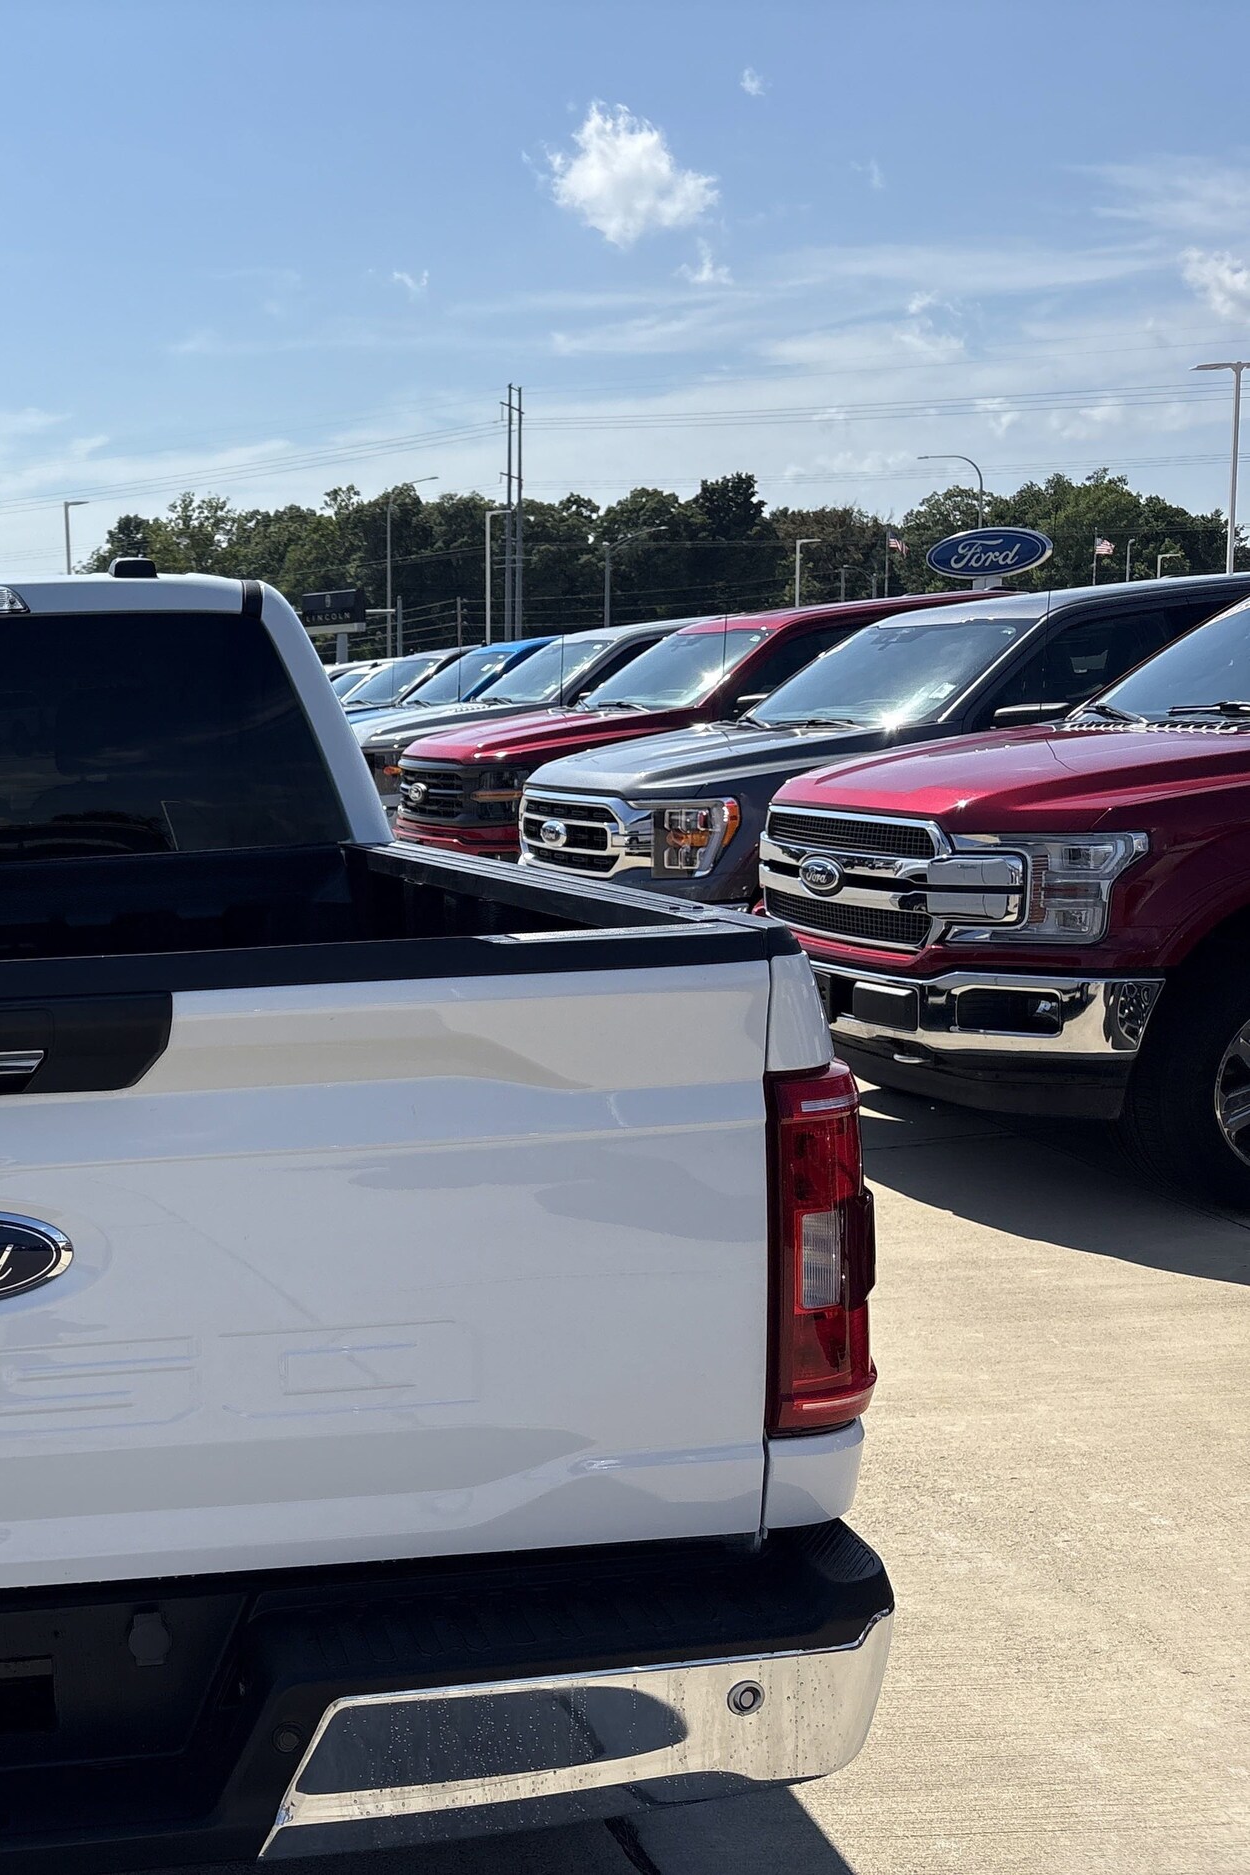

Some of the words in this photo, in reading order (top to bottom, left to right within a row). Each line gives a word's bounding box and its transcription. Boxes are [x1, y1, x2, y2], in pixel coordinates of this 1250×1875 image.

[950, 538, 1021, 569] Ford
[305, 612, 351, 623] LINCOLN
[806, 865, 828, 884] Ford
